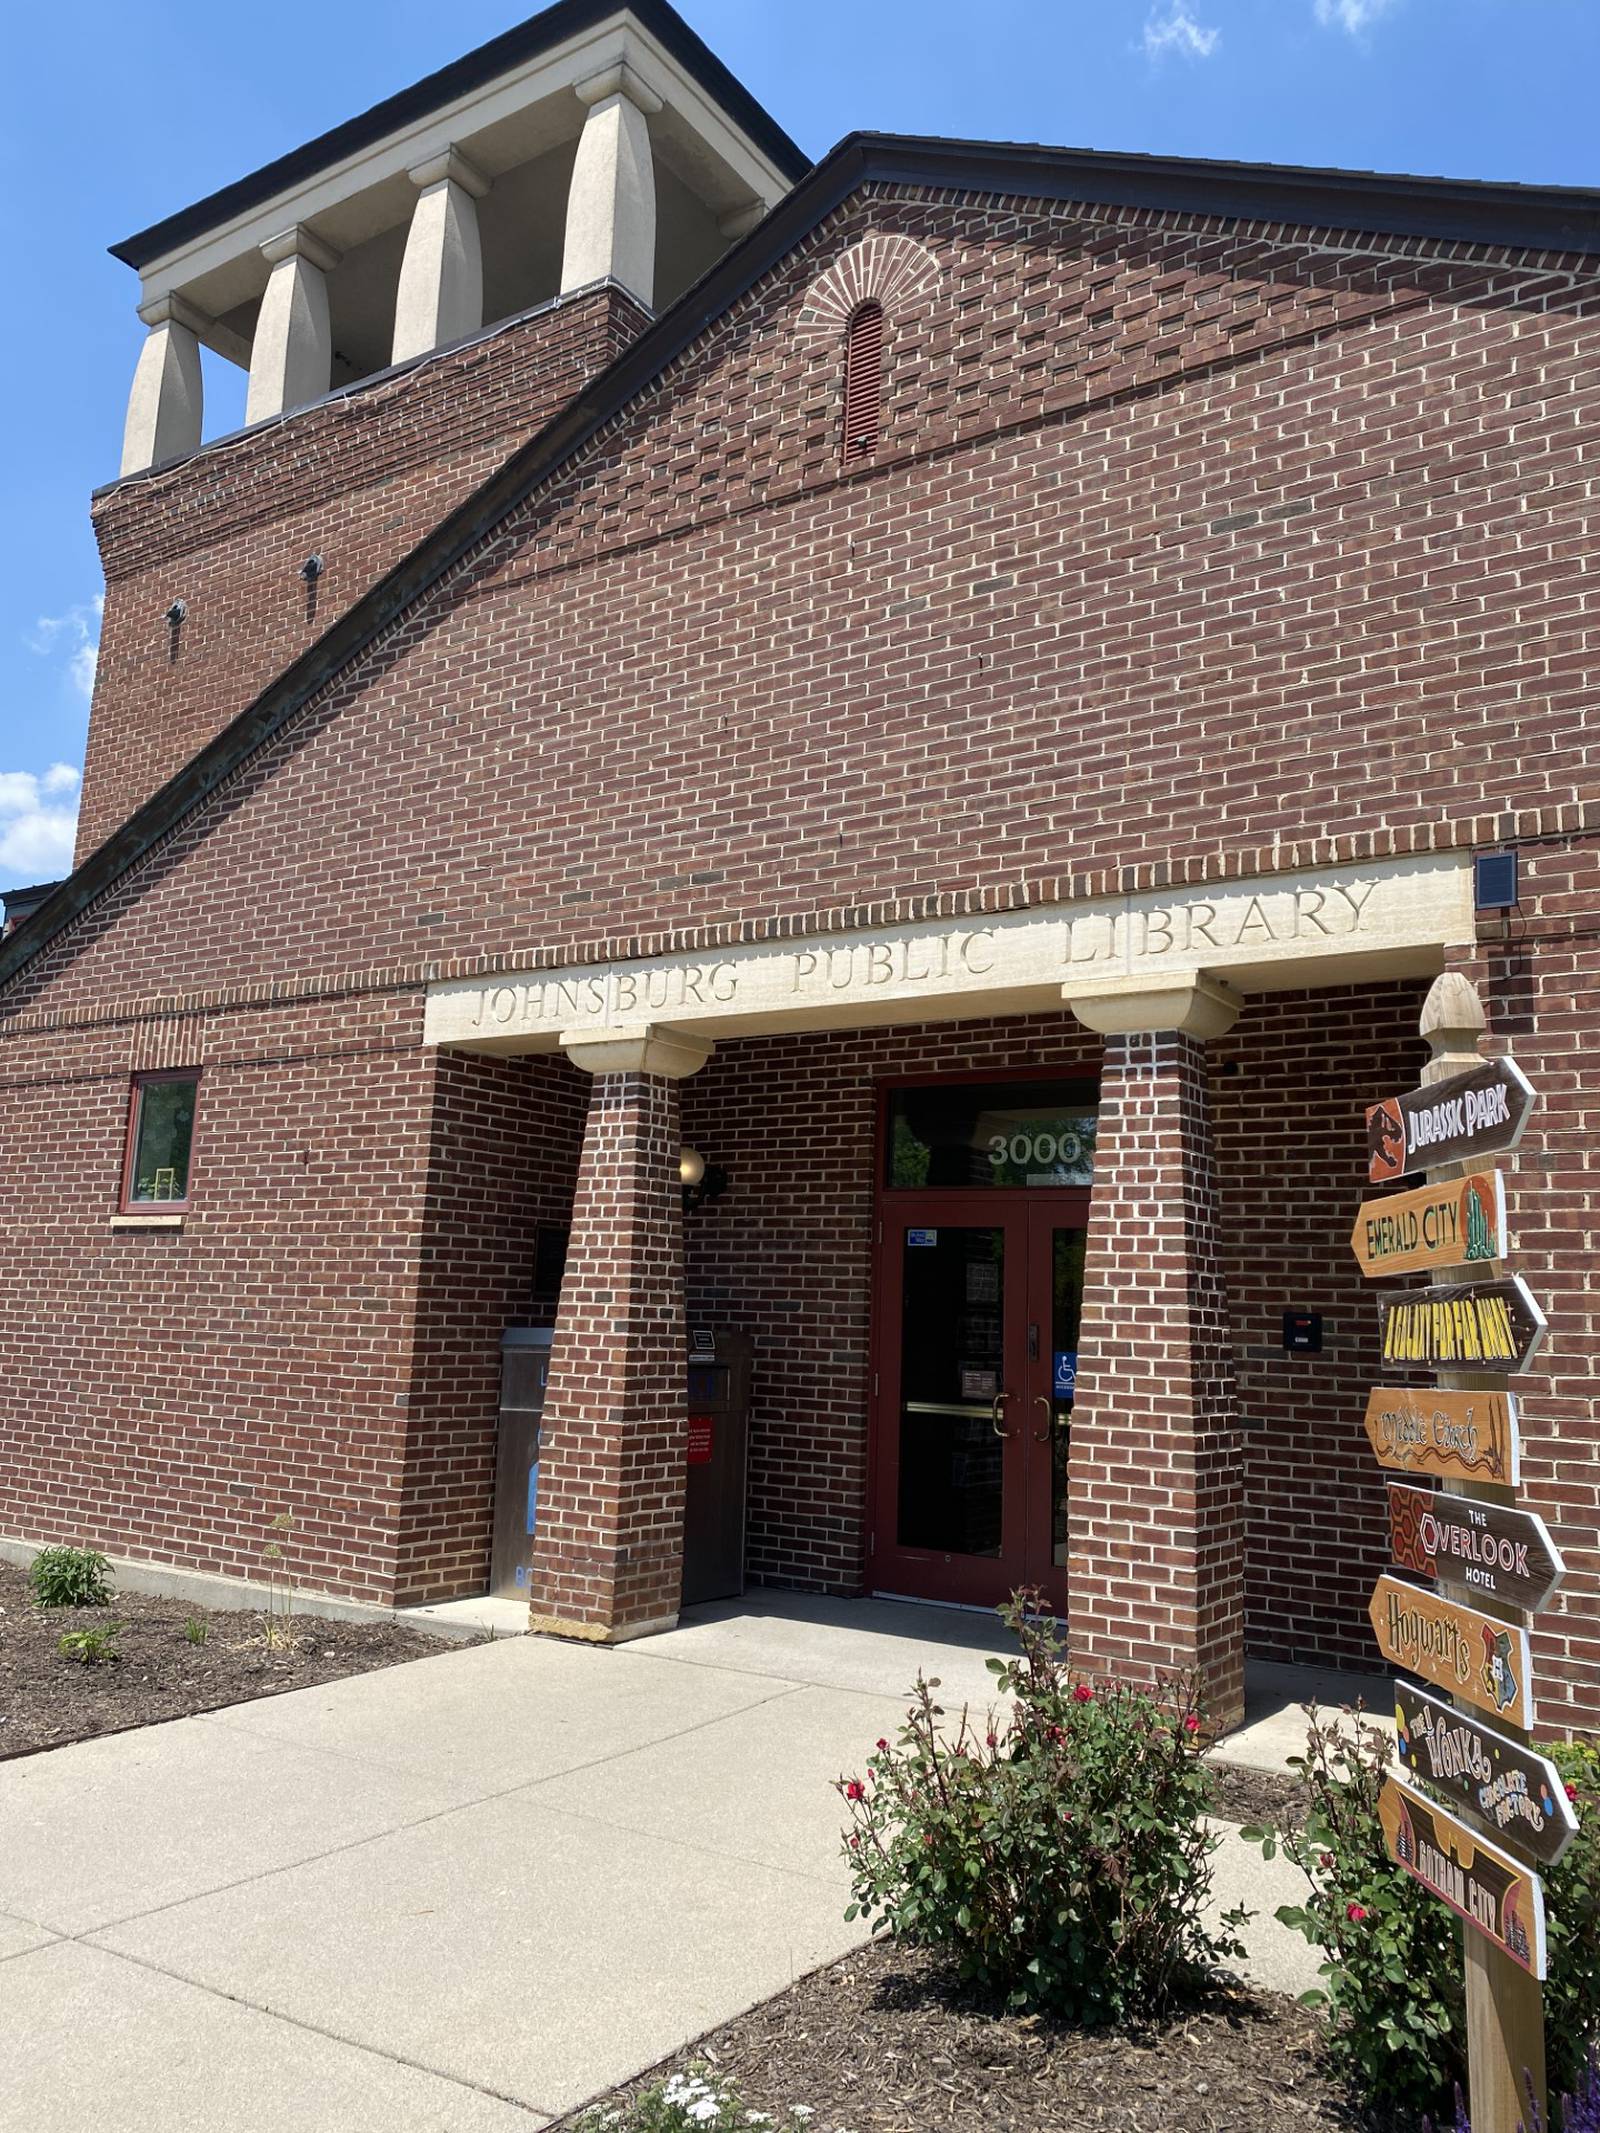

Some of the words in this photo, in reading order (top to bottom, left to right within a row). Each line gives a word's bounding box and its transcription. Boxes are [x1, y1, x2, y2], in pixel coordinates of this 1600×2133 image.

[471, 962, 738, 1027] JOHNSBURG
[790, 930, 995, 993] PUBLIC
[1061, 880, 1381, 965] LIBRARY
[988, 1132, 1082, 1165] 3000
[1408, 1098, 1465, 1154] JURASSIC
[1464, 1084, 1511, 1137] PARK
[1366, 1209, 1418, 1260] EMERALD
[1423, 1201, 1458, 1251] CITY
[1420, 1512, 1531, 1578] OVERLOOK
[1468, 1509, 1487, 1527] THE
[1465, 1566, 1497, 1590] HOTEL
[1386, 1592, 1470, 1685] Hogwarts
[1410, 1712, 1427, 1739] THE
[1425, 1716, 1491, 1784] WONKA
[1495, 1793, 1545, 1833] FACTORY
[1419, 1840, 1465, 1909] GOTHAM
[1469, 1877, 1496, 1935] CITY
